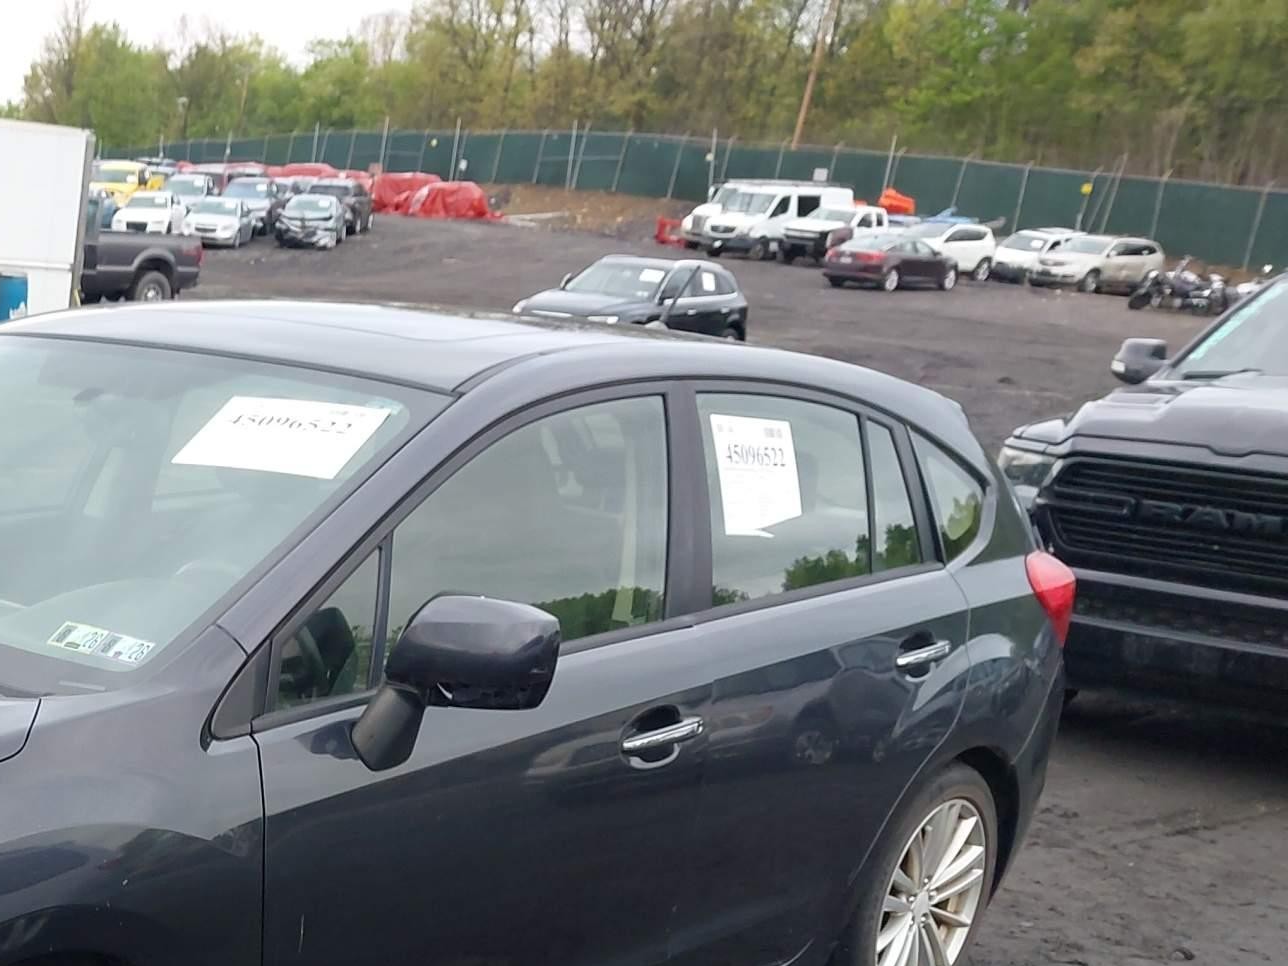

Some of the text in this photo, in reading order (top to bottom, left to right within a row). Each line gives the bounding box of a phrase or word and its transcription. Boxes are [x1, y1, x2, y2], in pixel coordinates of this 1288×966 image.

[230, 414, 353, 434] 45096522
[725, 443, 787, 467] 45096522
[1141, 499, 1283, 533] RAM
